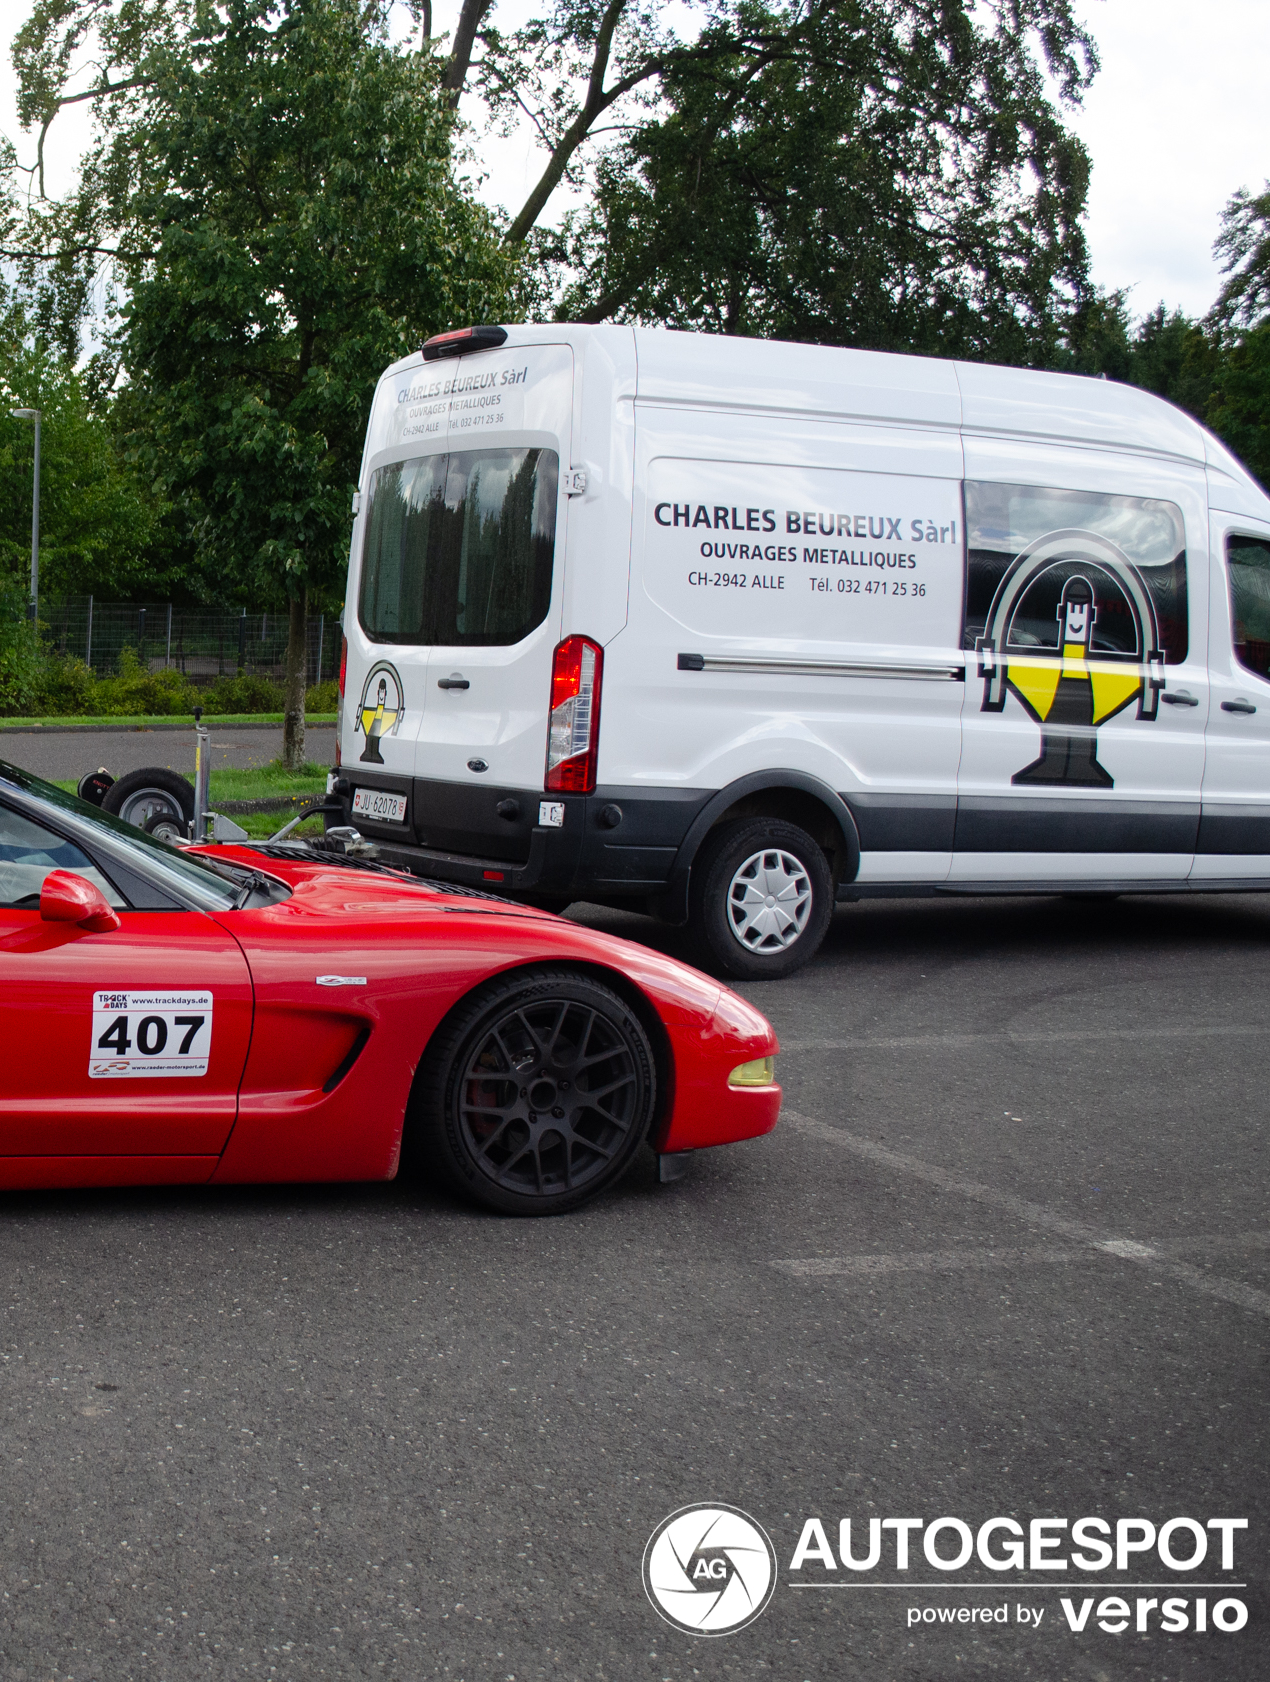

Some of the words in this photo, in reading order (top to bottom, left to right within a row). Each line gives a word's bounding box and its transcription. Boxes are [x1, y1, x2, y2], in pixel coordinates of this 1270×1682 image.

[397, 381, 442, 404] CHARLES
[443, 371, 498, 395] BEUREUX
[500, 367, 528, 386] Sàrl
[409, 402, 447, 419] OUVRAGES
[448, 394, 501, 412] METALLIQUES
[402, 424, 425, 437] CH-2942
[425, 422, 439, 433] ALLE
[449, 418, 458, 430] Tél.
[460, 417, 472, 428] 032
[473, 415, 485, 426] 471
[486, 414, 494, 425] 25
[495, 412, 504, 423] 36
[654, 502, 776, 533] CHARLES
[786, 510, 902, 541] BEUREUX
[910, 519, 956, 544] Sàrl
[700, 541, 797, 562] OUVRAGES
[802, 547, 917, 570] METALLIQUES
[688, 571, 747, 588] CH-2942
[751, 574, 785, 589] ALLE
[809, 577, 833, 592] Tél.
[837, 578, 861, 594] 032
[864, 580, 888, 595] 471
[892, 581, 908, 596] 25
[911, 583, 927, 597] 36
[131, 997, 209, 1006] www.trackdays.de
[97, 1015, 205, 1056] 407
[630, 1031, 651, 1087] MICHELIN
